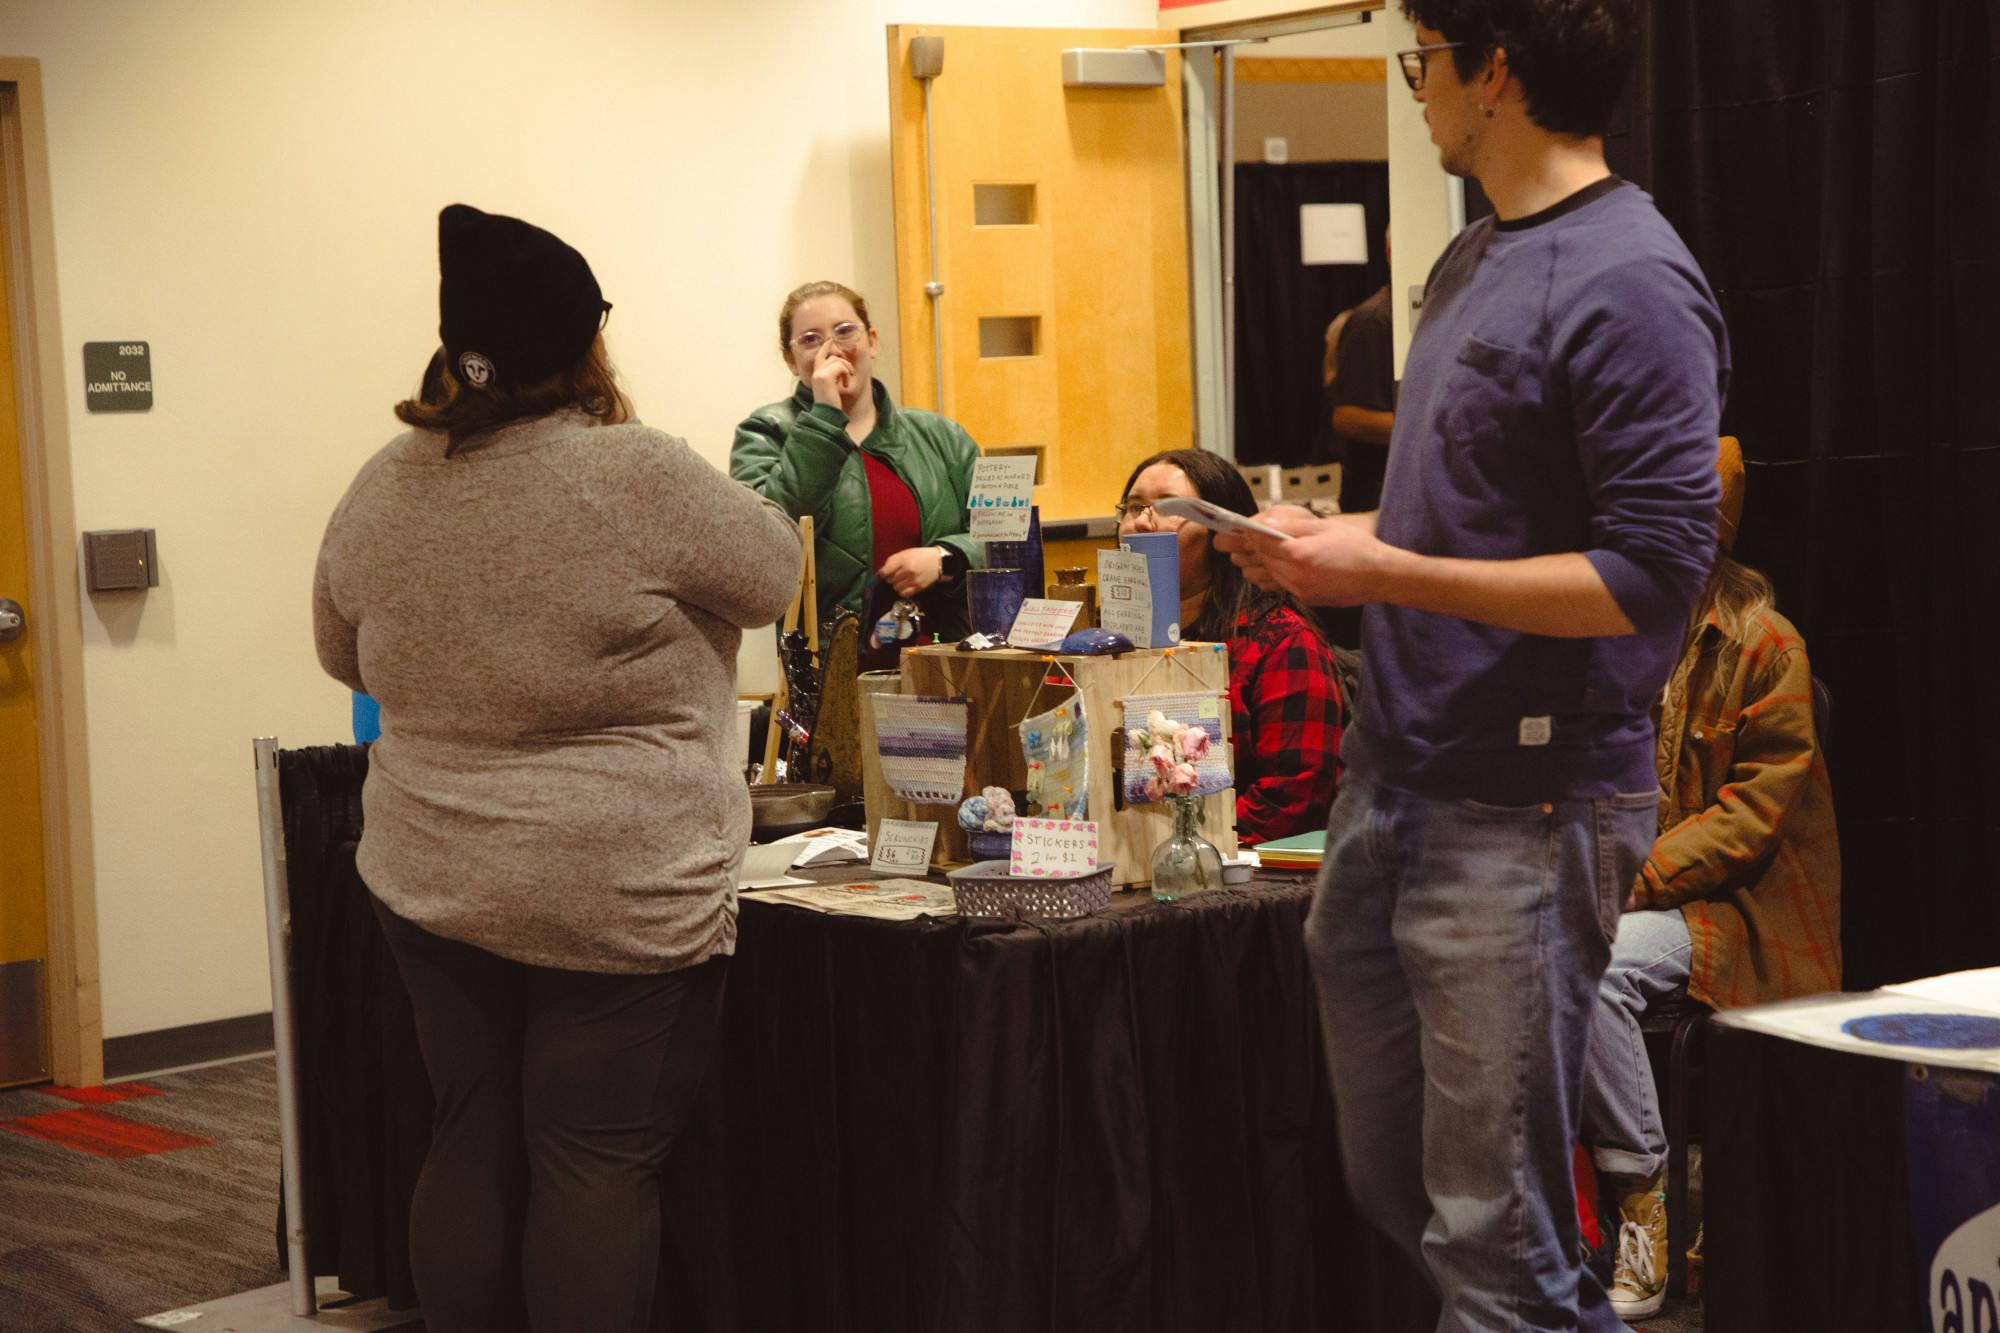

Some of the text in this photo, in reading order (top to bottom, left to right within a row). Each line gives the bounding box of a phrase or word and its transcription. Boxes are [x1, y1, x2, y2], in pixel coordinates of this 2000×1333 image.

[118, 345, 145, 356] 2032
[110, 371, 127, 381] NO
[87, 381, 152, 393] ADMITTANCE
[1102, 574, 1121, 583] CRANE
[1026, 833, 1086, 850] STICKERS
[886, 848, 897, 859] $6
[1030, 852, 1041, 865] 2
[1062, 852, 1077, 864] $1
